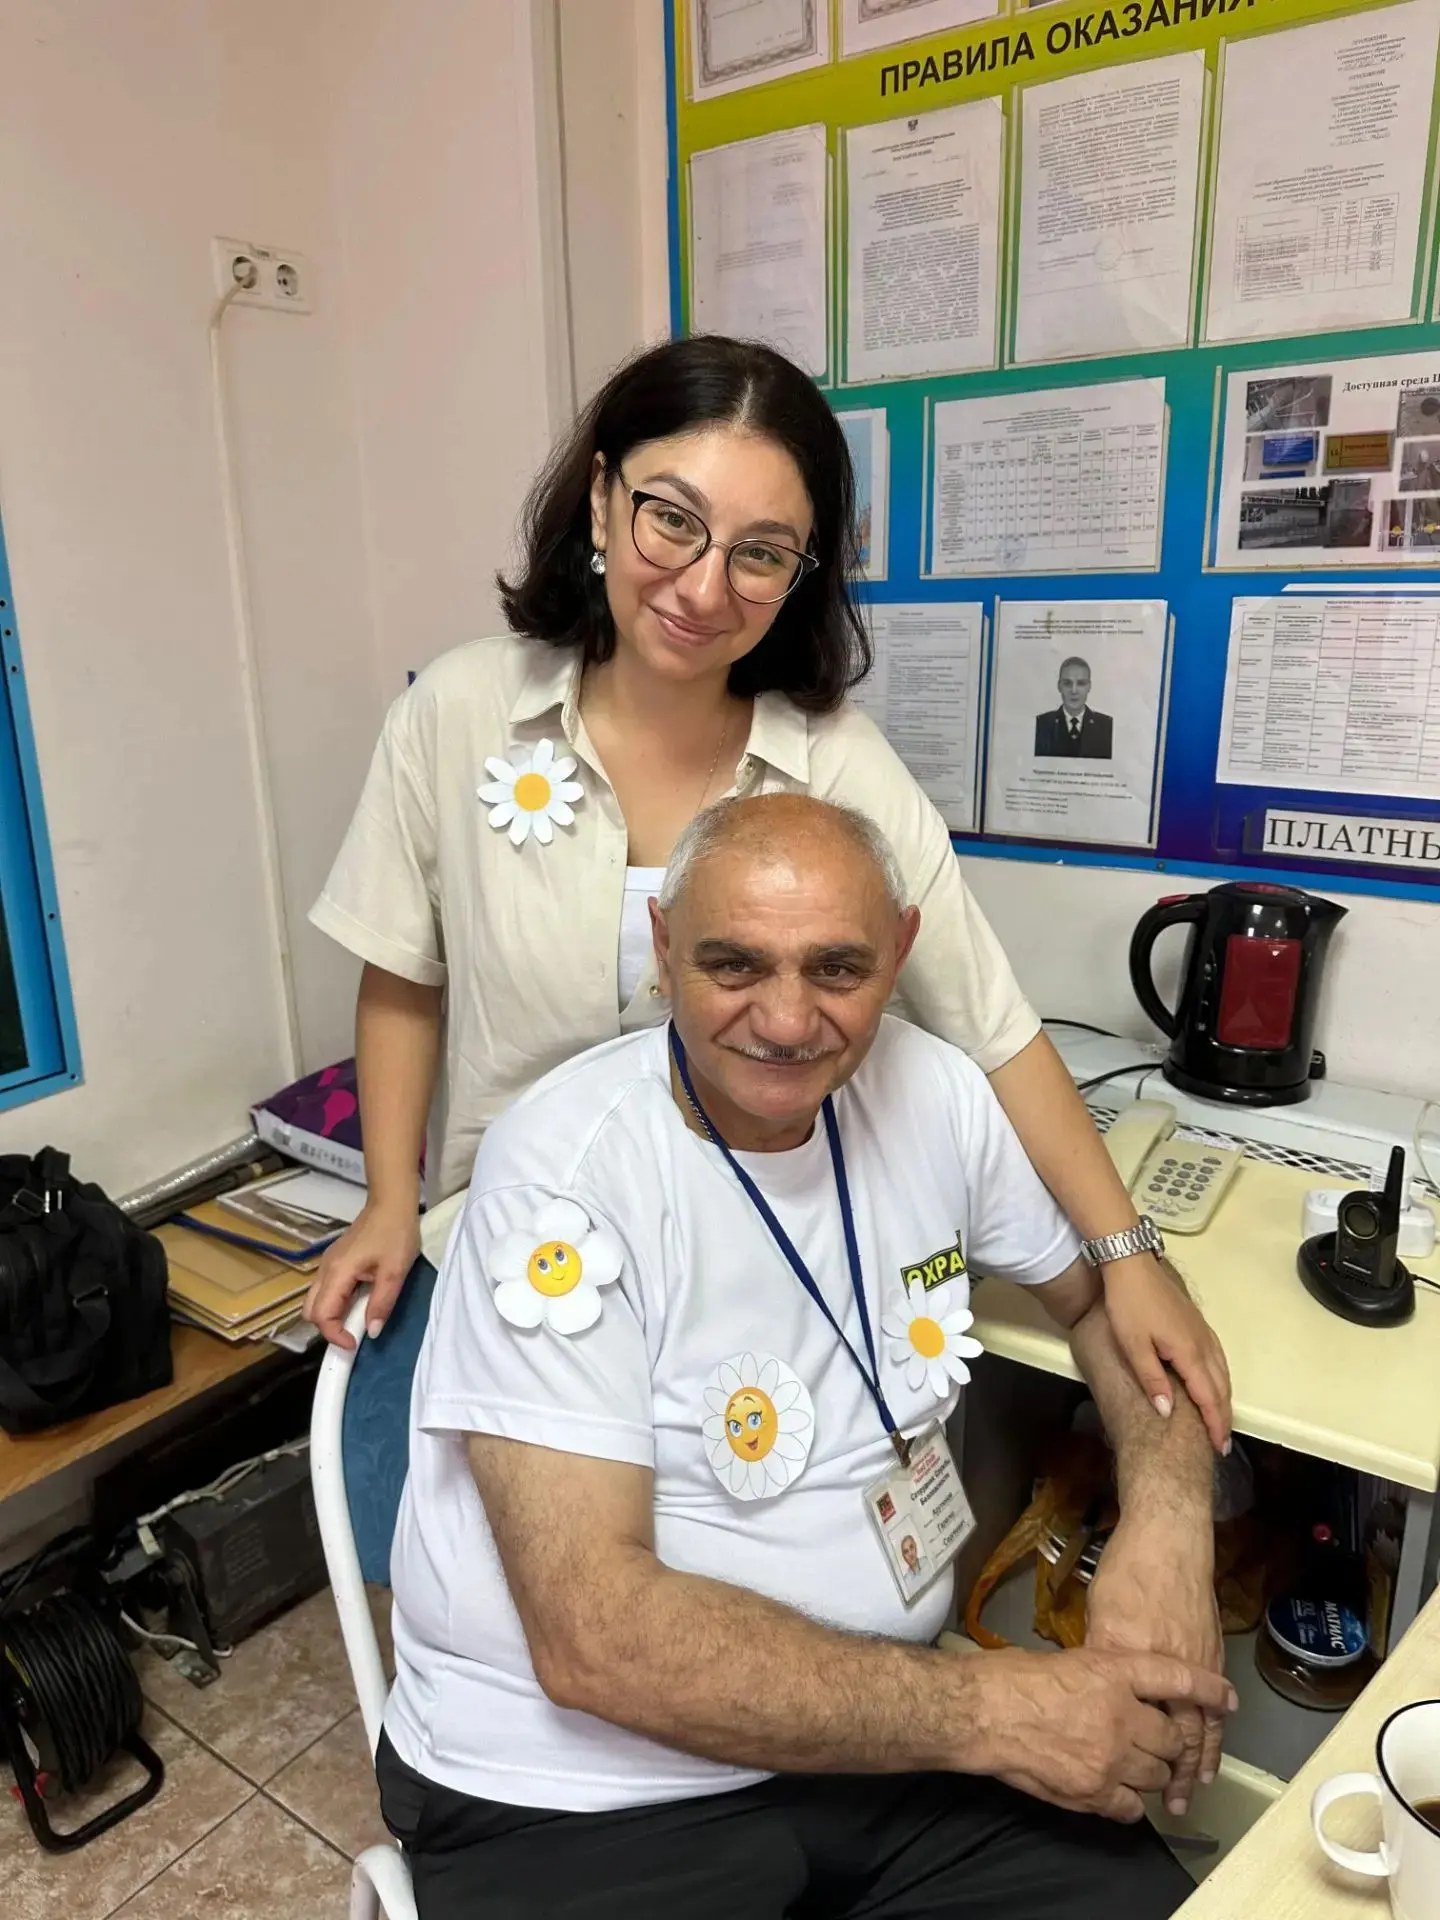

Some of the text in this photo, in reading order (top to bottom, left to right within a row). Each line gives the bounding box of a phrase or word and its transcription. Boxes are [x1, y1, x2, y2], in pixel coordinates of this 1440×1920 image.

[881, 31, 1035, 96] ПРАВИЛА
[1342, 379, 1398, 393] Доступная
[1400, 376, 1430, 388] среда
[906, 1250, 965, 1288] ОХРА
